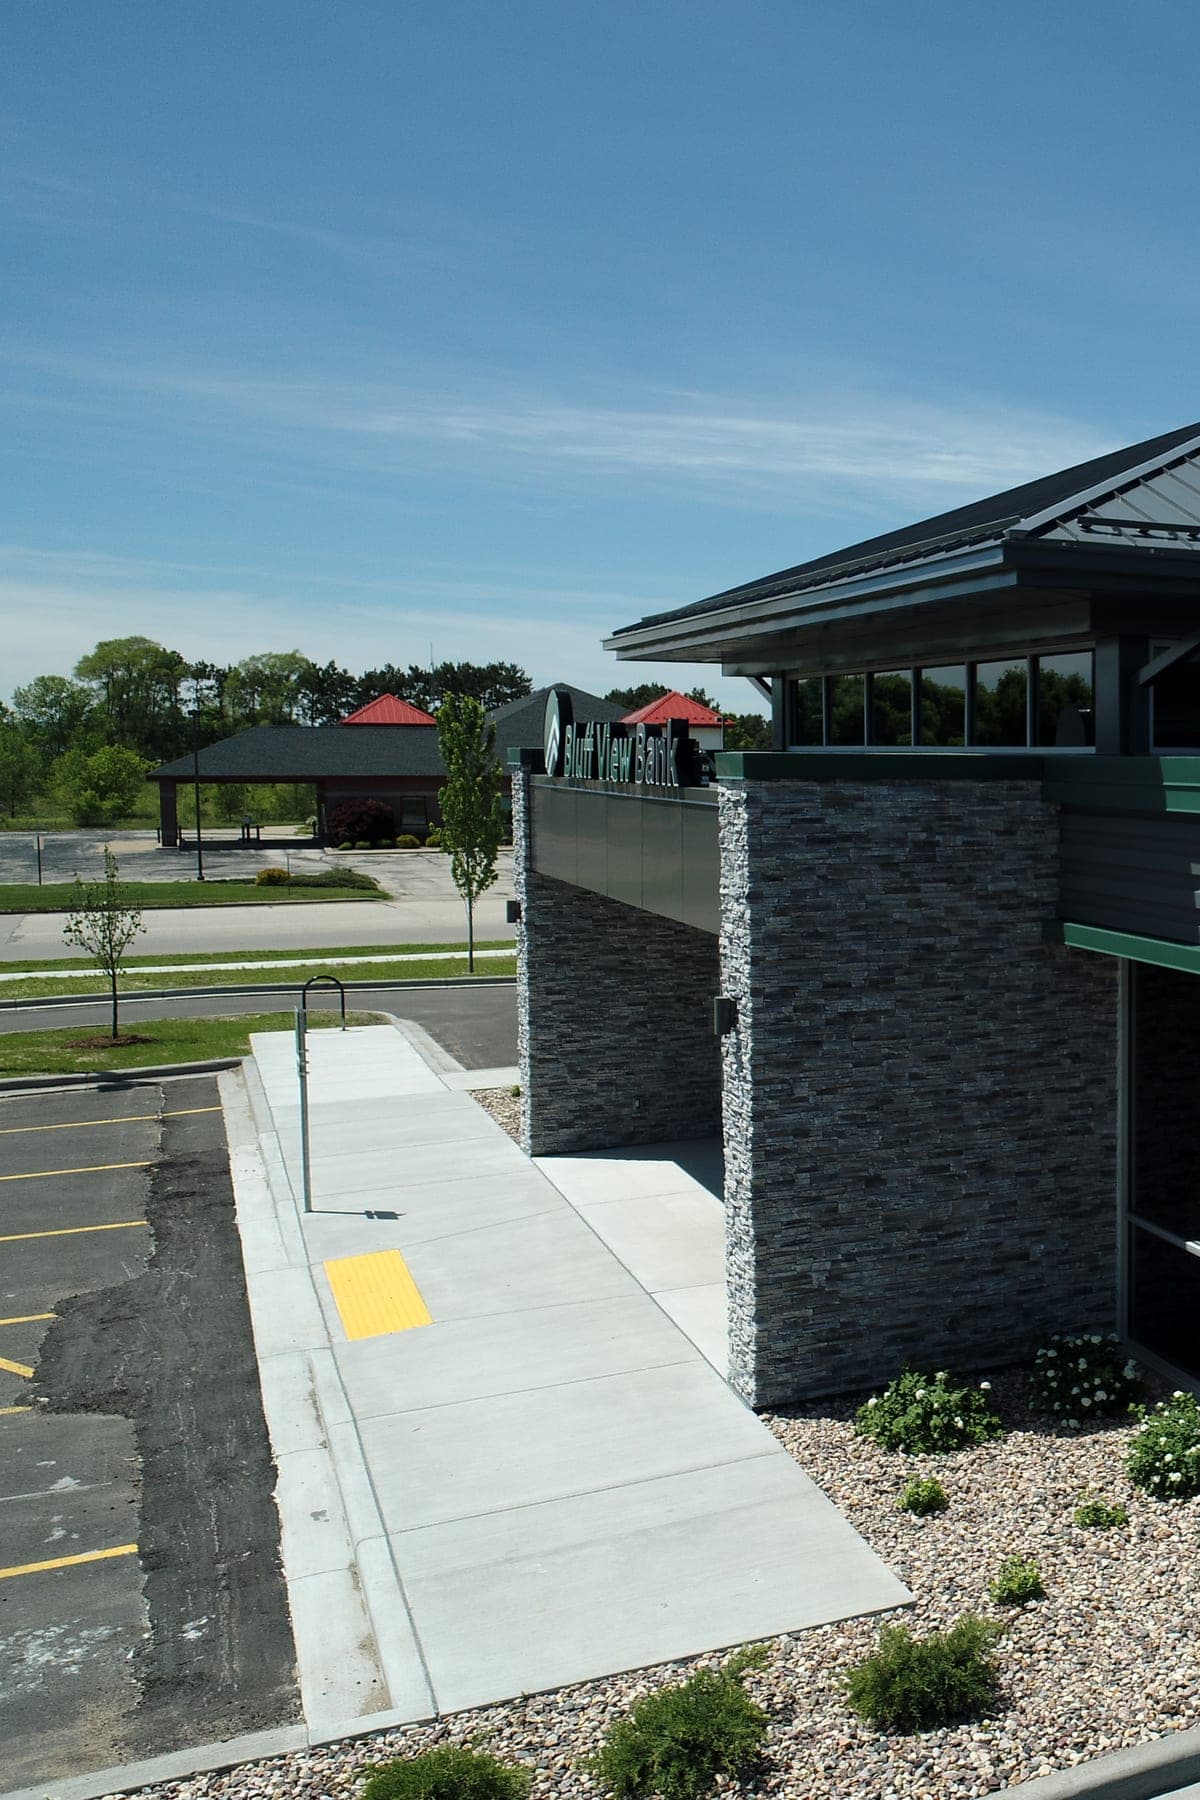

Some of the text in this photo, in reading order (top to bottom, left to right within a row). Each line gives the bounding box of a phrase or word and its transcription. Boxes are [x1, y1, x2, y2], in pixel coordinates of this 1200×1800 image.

[564, 719, 679, 786] Bluff View Bank
